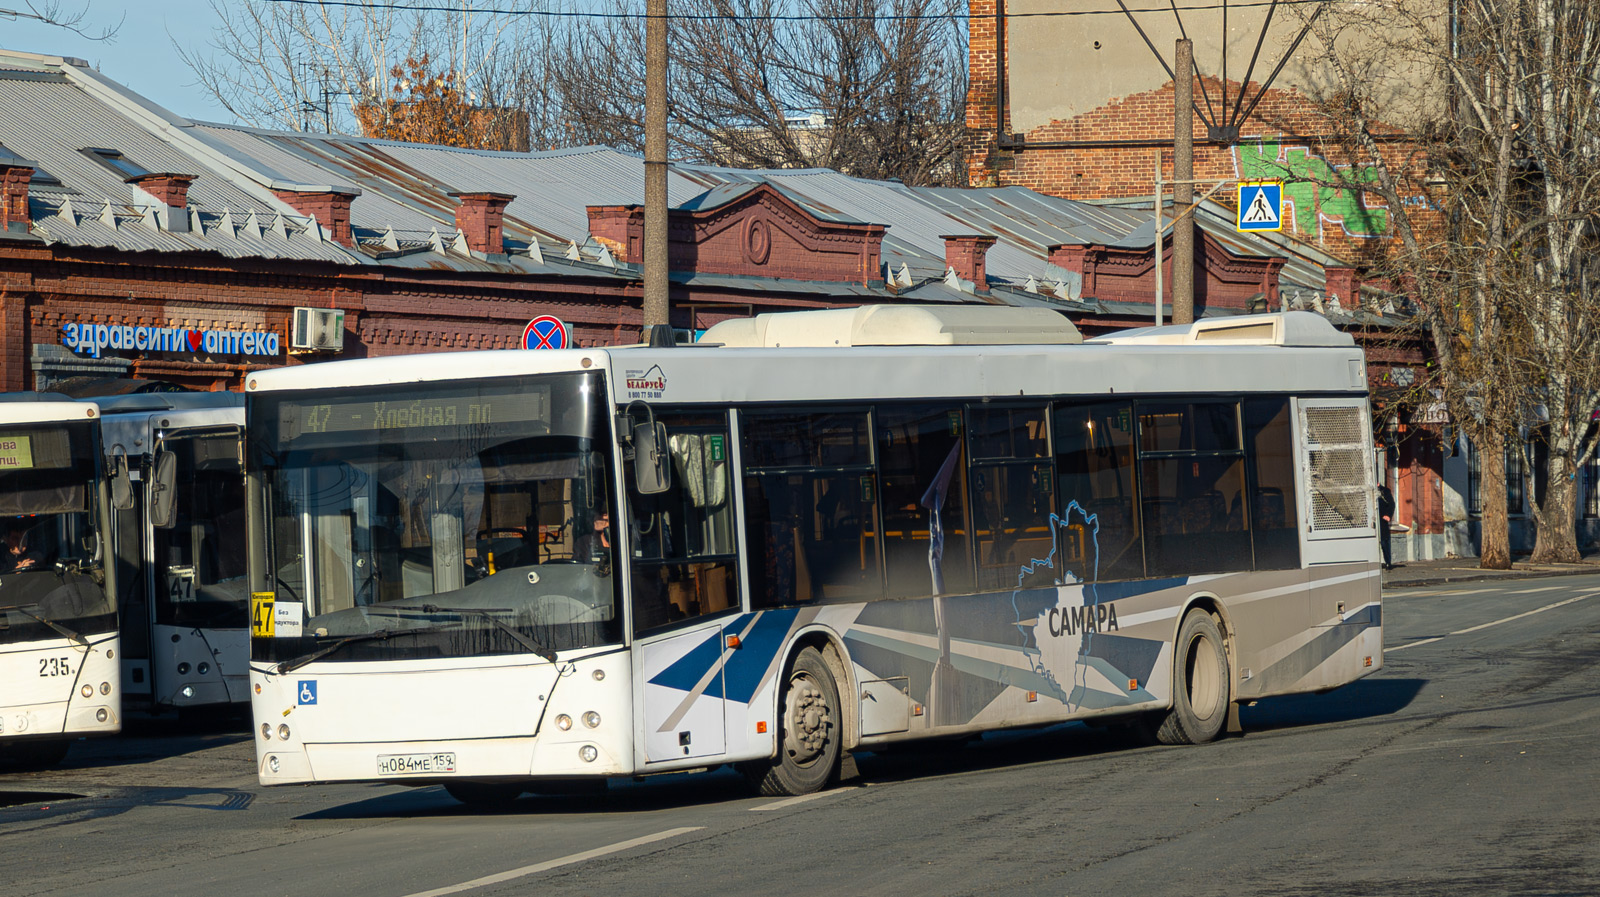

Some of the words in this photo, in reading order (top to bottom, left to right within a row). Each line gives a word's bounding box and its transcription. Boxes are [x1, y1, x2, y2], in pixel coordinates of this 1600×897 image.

[63, 322, 186, 358] здравсити
[203, 329, 280, 356] аптека
[626, 377, 664, 389] БЕЛАРУСЬ
[307, 404, 332, 432] 47
[373, 399, 457, 429] Хлебная
[0, 441, 16, 450] ва
[170, 576, 192, 600] 47
[253, 601, 274, 632] 47
[1048, 603, 1119, 638] САМАРА
[39, 657, 70, 677] 235
[381, 757, 430, 773] Н084МЕ
[433, 755, 453, 766] 159
